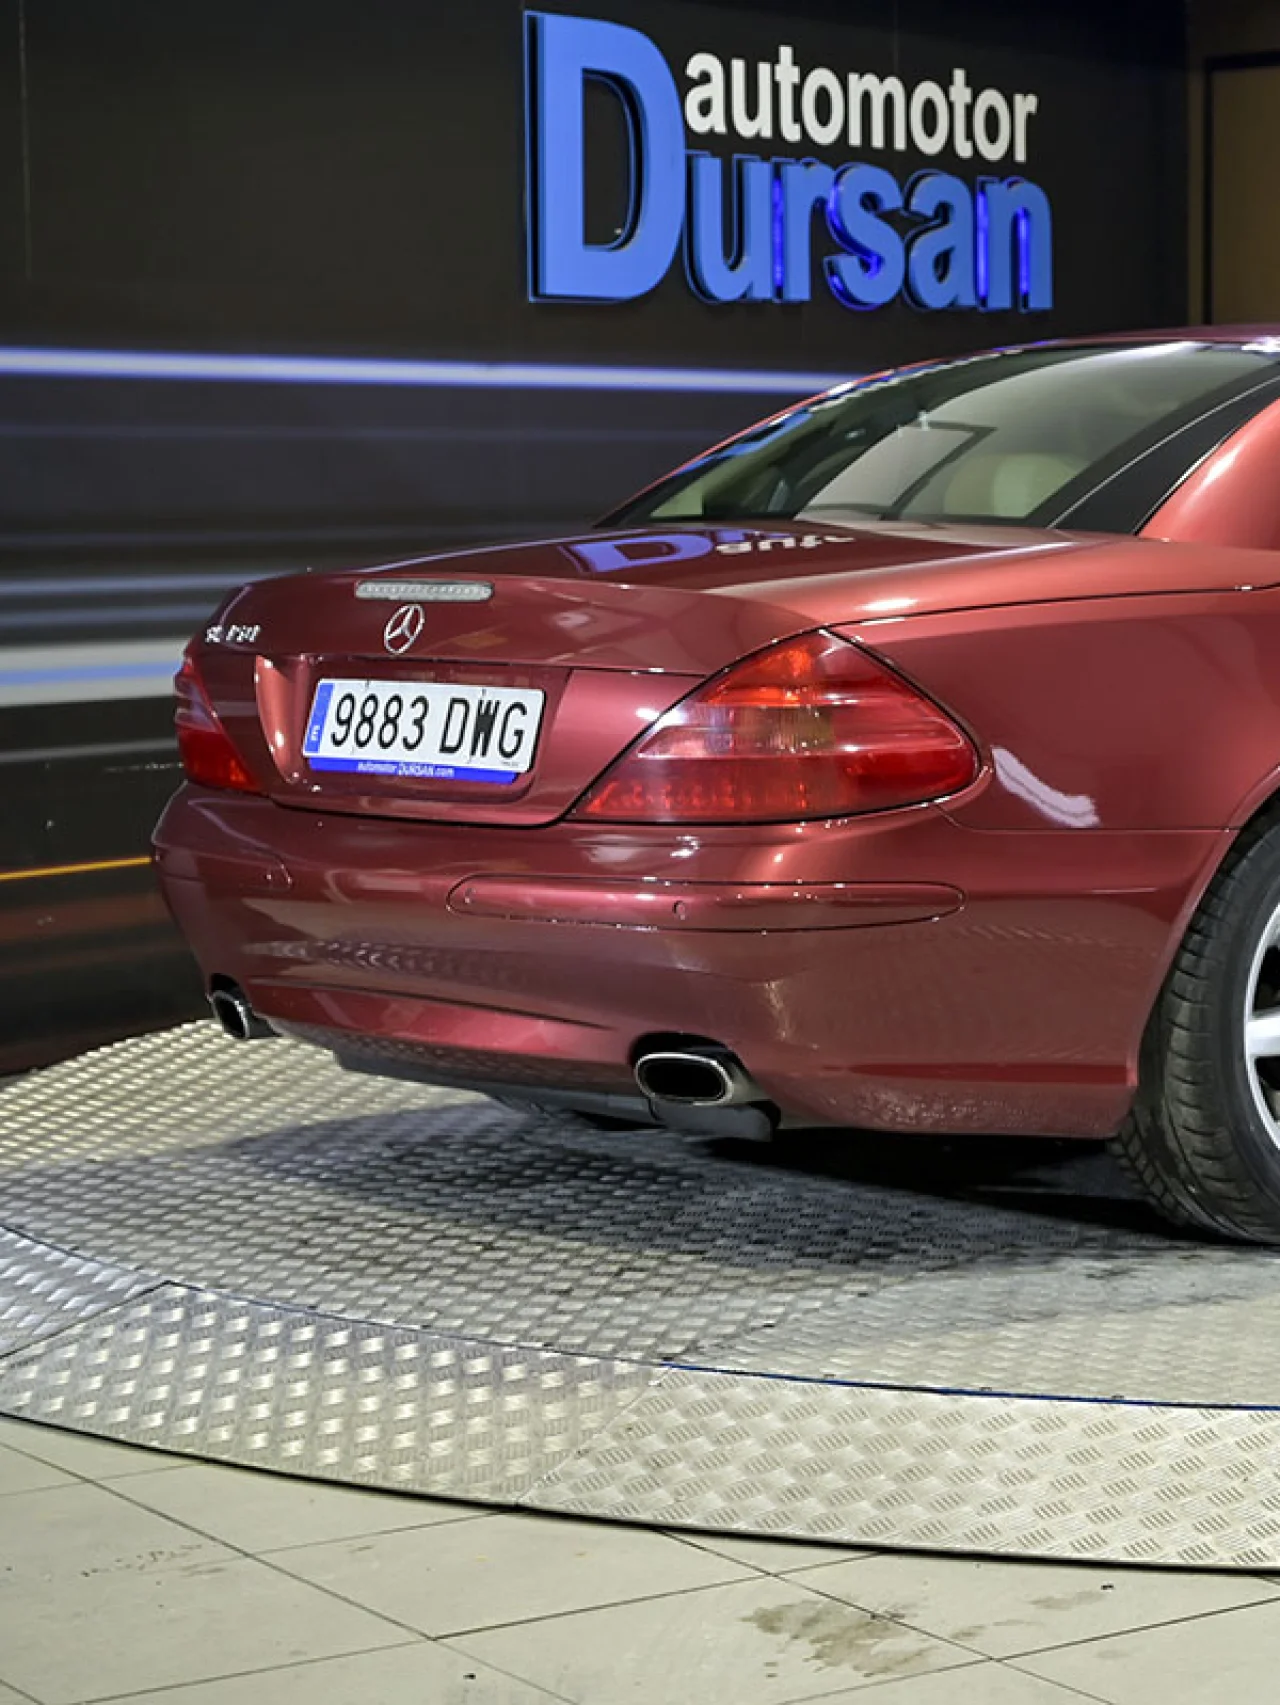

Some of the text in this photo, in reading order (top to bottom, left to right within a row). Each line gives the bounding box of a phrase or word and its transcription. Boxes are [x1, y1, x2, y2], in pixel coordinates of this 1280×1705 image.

[524, 10, 1053, 312] Dursan
[684, 45, 1037, 162] automotor
[330, 692, 528, 759] 9883 DWG
